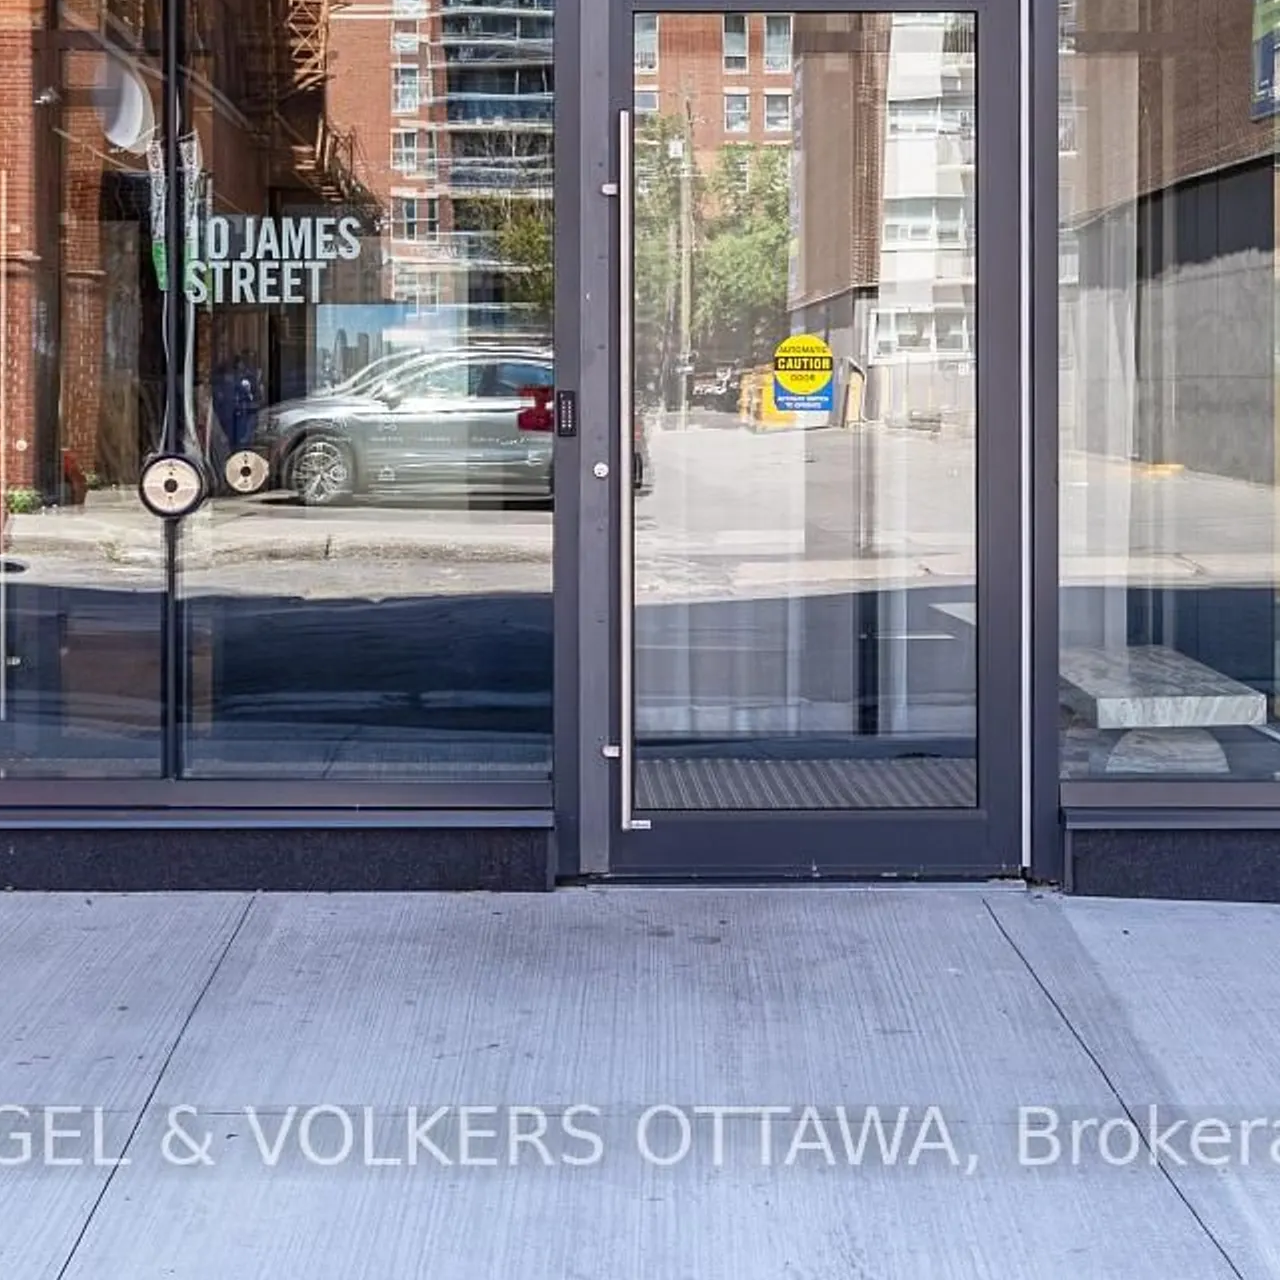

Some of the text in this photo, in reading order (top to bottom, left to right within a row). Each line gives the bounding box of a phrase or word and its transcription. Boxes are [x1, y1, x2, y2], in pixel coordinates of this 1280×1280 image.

[187, 215, 363, 261] 10 JAMES
[184, 260, 328, 305] STREET
[777, 357, 831, 370] CAUTION
